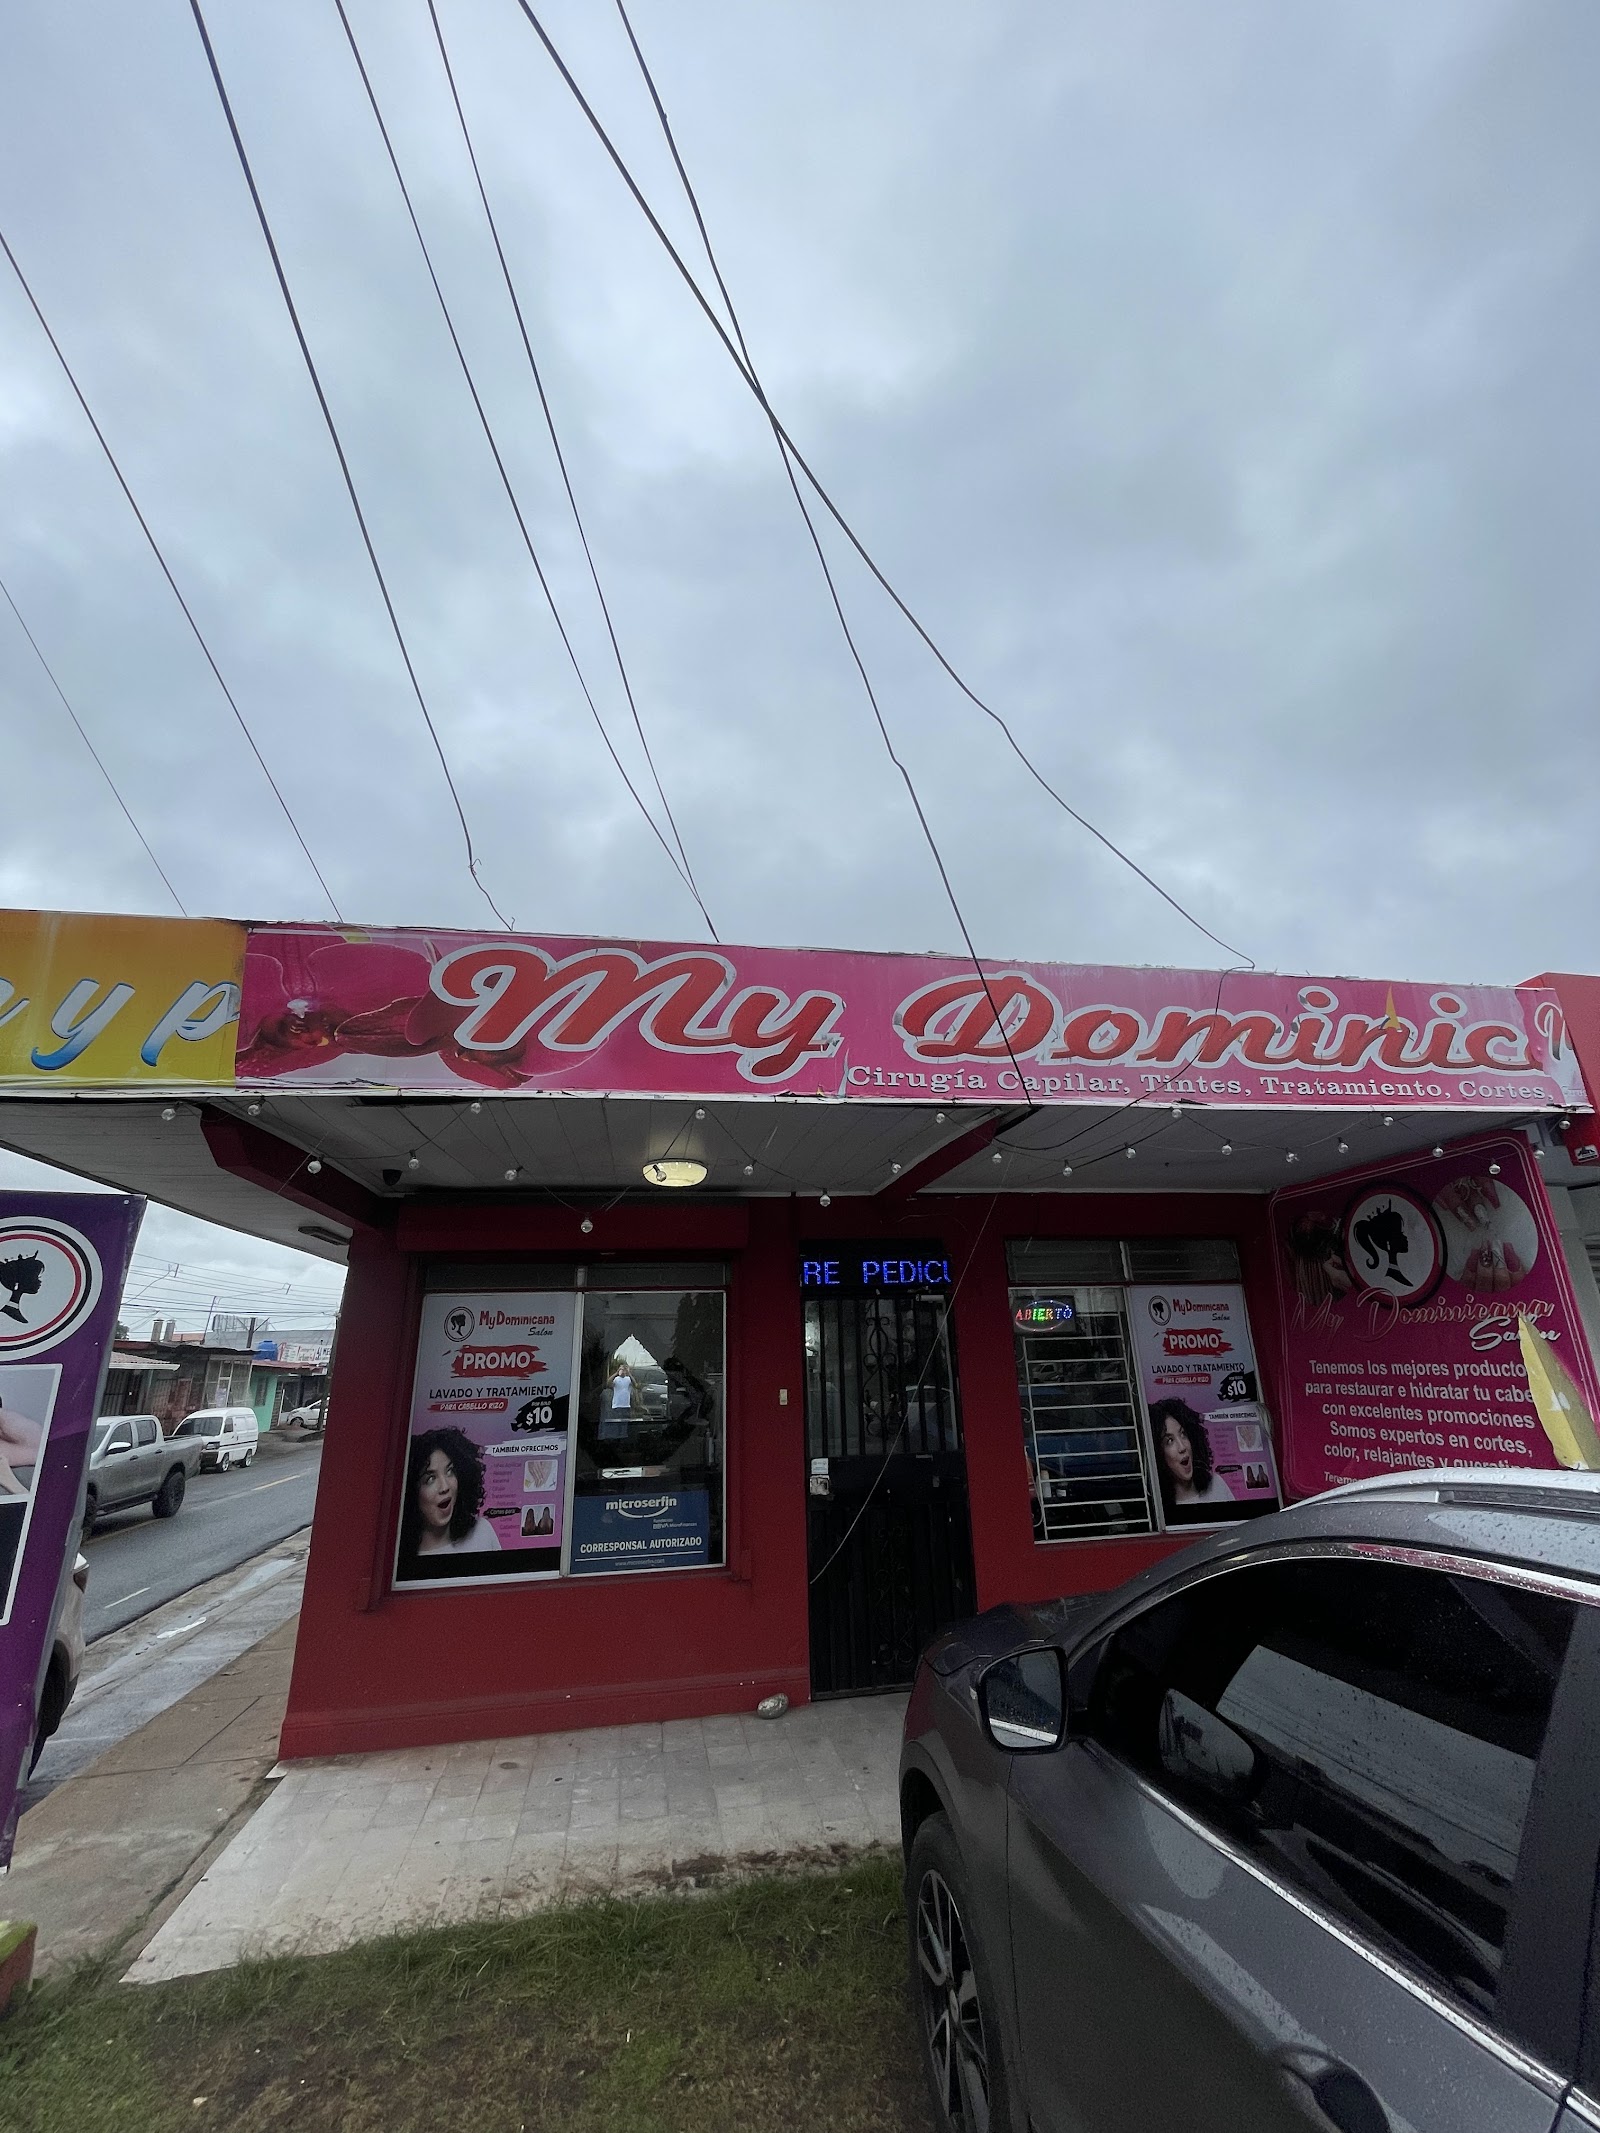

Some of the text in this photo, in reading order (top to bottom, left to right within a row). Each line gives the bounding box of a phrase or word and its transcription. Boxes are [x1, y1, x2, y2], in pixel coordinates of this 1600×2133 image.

[429, 942, 846, 1083] My
[847, 1066, 987, 1093] Cirugía
[997, 1070, 1130, 1096] Capilar,
[1139, 1074, 1251, 1096] Tintes,
[1259, 1076, 1451, 1099] Tratamiento,
[1458, 1081, 1554, 1101] Cortes,
[803, 1261, 841, 1284] RE
[1016, 1307, 1072, 1320] ABIERTO
[1169, 1334, 1220, 1349] PROMO
[462, 1352, 531, 1370] PROMO
[1152, 1363, 1245, 1374] LAVADO Y TRATAMIENTO
[1309, 1359, 1364, 1375] Tenemos
[1367, 1360, 1388, 1376] los
[1391, 1361, 1449, 1379] mejores
[430, 1385, 558, 1399] LAVADO Y TRATAMIENTO
[1228, 1380, 1247, 1396] $10
[1305, 1382, 1332, 1396] para
[1335, 1383, 1394, 1397] restaurar
[1398, 1386, 1406, 1397] e
[1409, 1382, 1469, 1401] hidratar
[1473, 1385, 1490, 1401] tu
[440, 1403, 457, 1411] PARA
[457, 1402, 488, 1410] CABELLO
[526, 1406, 553, 1426] $10
[1322, 1403, 1535, 1429] con excelentes promociones
[1330, 1420, 1533, 1457] Somos expertos en cortes,
[521, 1444, 559, 1452] OFRECEMOS
[1324, 1442, 1360, 1462] color,
[1364, 1445, 1435, 1468] relajantes
[605, 1496, 677, 1510] microserfin
[580, 1537, 702, 1553] CORRESPONSAL AUTORIZADO
